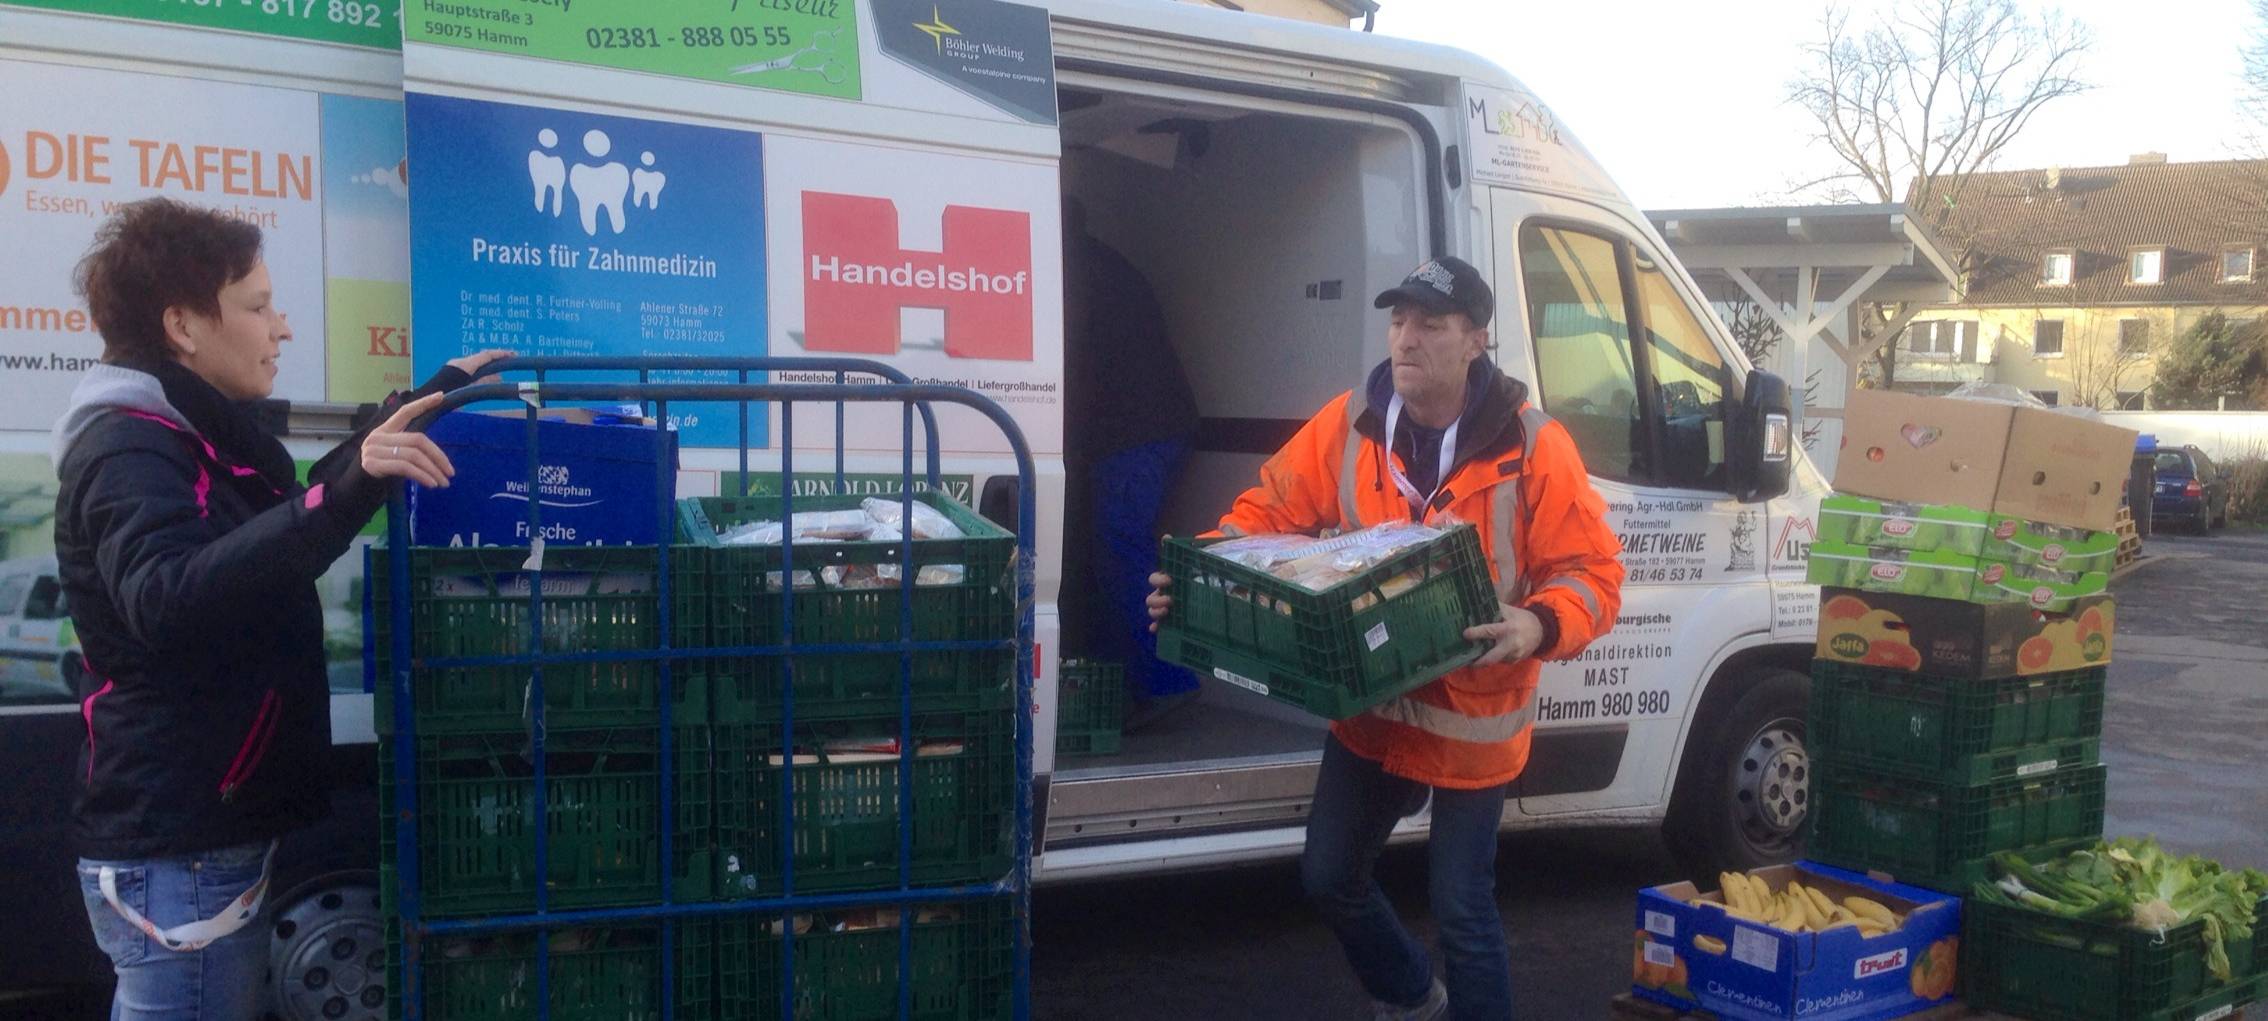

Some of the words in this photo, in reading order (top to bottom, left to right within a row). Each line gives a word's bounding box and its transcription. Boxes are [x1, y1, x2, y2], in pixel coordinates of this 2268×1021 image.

[327, 0, 381, 28] 892
[424, 0, 520, 25] Hauptstraße
[525, 13, 534, 26] 3
[425, 21, 472, 39] 59075
[478, 28, 528, 47] Hamm
[586, 28, 661, 48] 02381
[682, 27, 725, 47] 888
[730, 27, 758, 46] 05
[764, 26, 791, 46] 55
[945, 37, 980, 54] Böhler
[982, 43, 1025, 62] Welding
[946, 50, 980, 61] GROUP
[1012, 74, 1046, 85] company
[26, 131, 111, 185] DIE
[129, 139, 313, 201] TAFELN
[26, 189, 96, 218] Essen,
[473, 238, 542, 267] Praxis
[549, 244, 580, 268] für
[588, 247, 717, 278] Zahnmedizin
[811, 254, 1027, 295] Handelshof
[640, 302, 676, 314] Ahlener
[678, 303, 710, 316] Straße
[492, 319, 525, 332] Scholz
[673, 317, 702, 329] Hamm
[779, 372, 837, 385] Handelsho
[977, 380, 1056, 393] Liefergroßhandel
[1607, 502, 1633, 513] ering
[516, 521, 576, 541] Frsche
[1623, 519, 1671, 529] Futtermittel
[1669, 567, 1685, 581] 53
[1689, 568, 1703, 580] 74
[1831, 637, 1865, 653] Jaffa
[1584, 667, 1629, 687] MAST
[1537, 696, 1596, 721] Hamm
[1601, 692, 1633, 717] 980
[1637, 690, 1670, 715] 980
